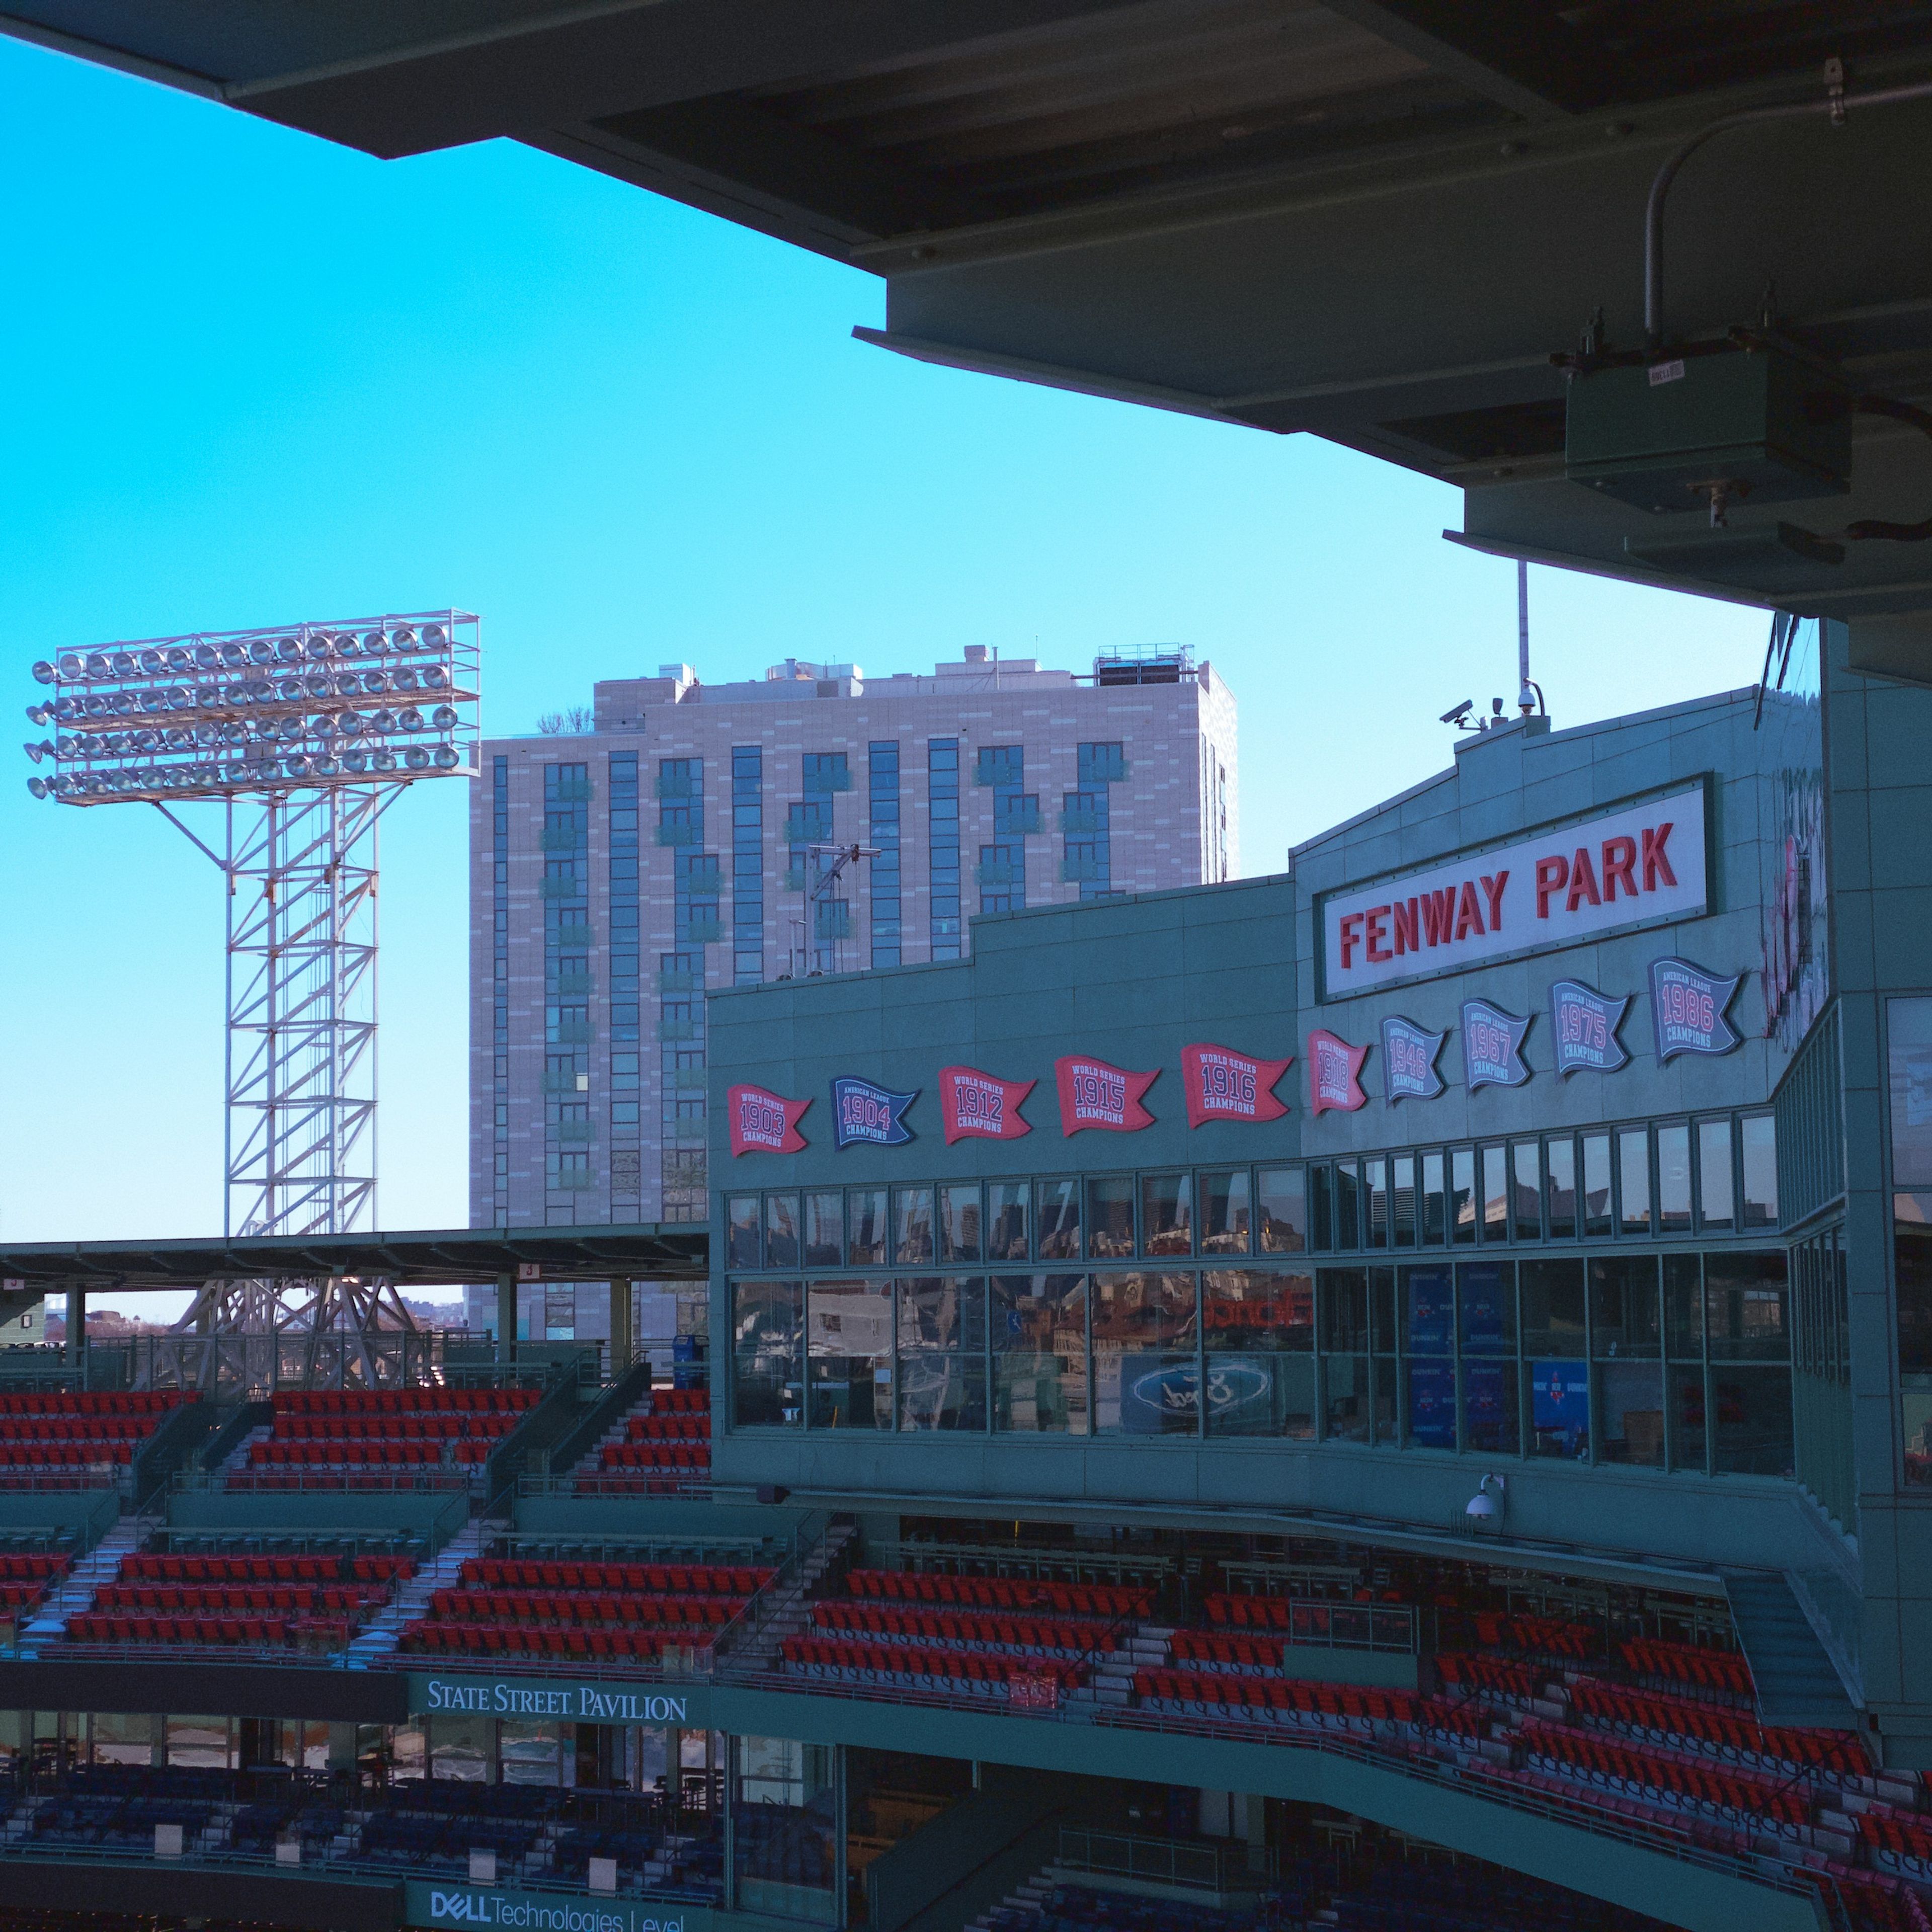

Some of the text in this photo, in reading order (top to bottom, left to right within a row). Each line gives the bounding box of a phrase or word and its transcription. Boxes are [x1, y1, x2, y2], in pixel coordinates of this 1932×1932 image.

[1339, 822, 1678, 970] FENWAY PARK
[1663, 971, 1711, 993] AMERICAN LEAGUE
[1561, 992, 1604, 1013] AMERICAN LEAGUE
[1662, 984, 1714, 1032] 1986
[1561, 1004, 1606, 1050] 1975
[1667, 1026, 1711, 1048] CHAMPIONS
[1317, 1040, 1348, 1060] WORLD SERIES
[1471, 1023, 1510, 1066] 1967
[1565, 1043, 1603, 1064] CHAMPIONS
[1199, 1054, 1256, 1074] WORLD SERIES
[1390, 1039, 1426, 1079] 1946
[1072, 1066, 1125, 1084] WORLD SERIES
[1318, 1052, 1348, 1090] 1918
[1474, 1061, 1508, 1080] CHAMPIONS
[954, 1076, 1003, 1095] WORLD SERIES
[1201, 1065, 1256, 1102] 1916
[1393, 1074, 1424, 1092] CHAMPIONS
[741, 1093, 784, 1111] WORLD SERIES
[844, 1087, 890, 1103] AMERICAN LEAGUE
[956, 1086, 1003, 1122] 1912
[1074, 1076, 1124, 1112] 1915
[1320, 1086, 1348, 1103] CHAMPIONS
[843, 1096, 891, 1131] 1904
[1076, 1107, 1123, 1124] CHAMPIONS
[1204, 1097, 1255, 1115] CHAMPIONS
[741, 1103, 785, 1137] 1903
[958, 1116, 1002, 1133] CHAMPIONS
[743, 1132, 781, 1147] CHAMPIONS
[846, 1124, 887, 1141] CHAMPIONS
[428, 1681, 687, 1722] STATE STREET PAVILION
[431, 1892, 491, 1922] DELL
[491, 1897, 623, 1932] Technologies
